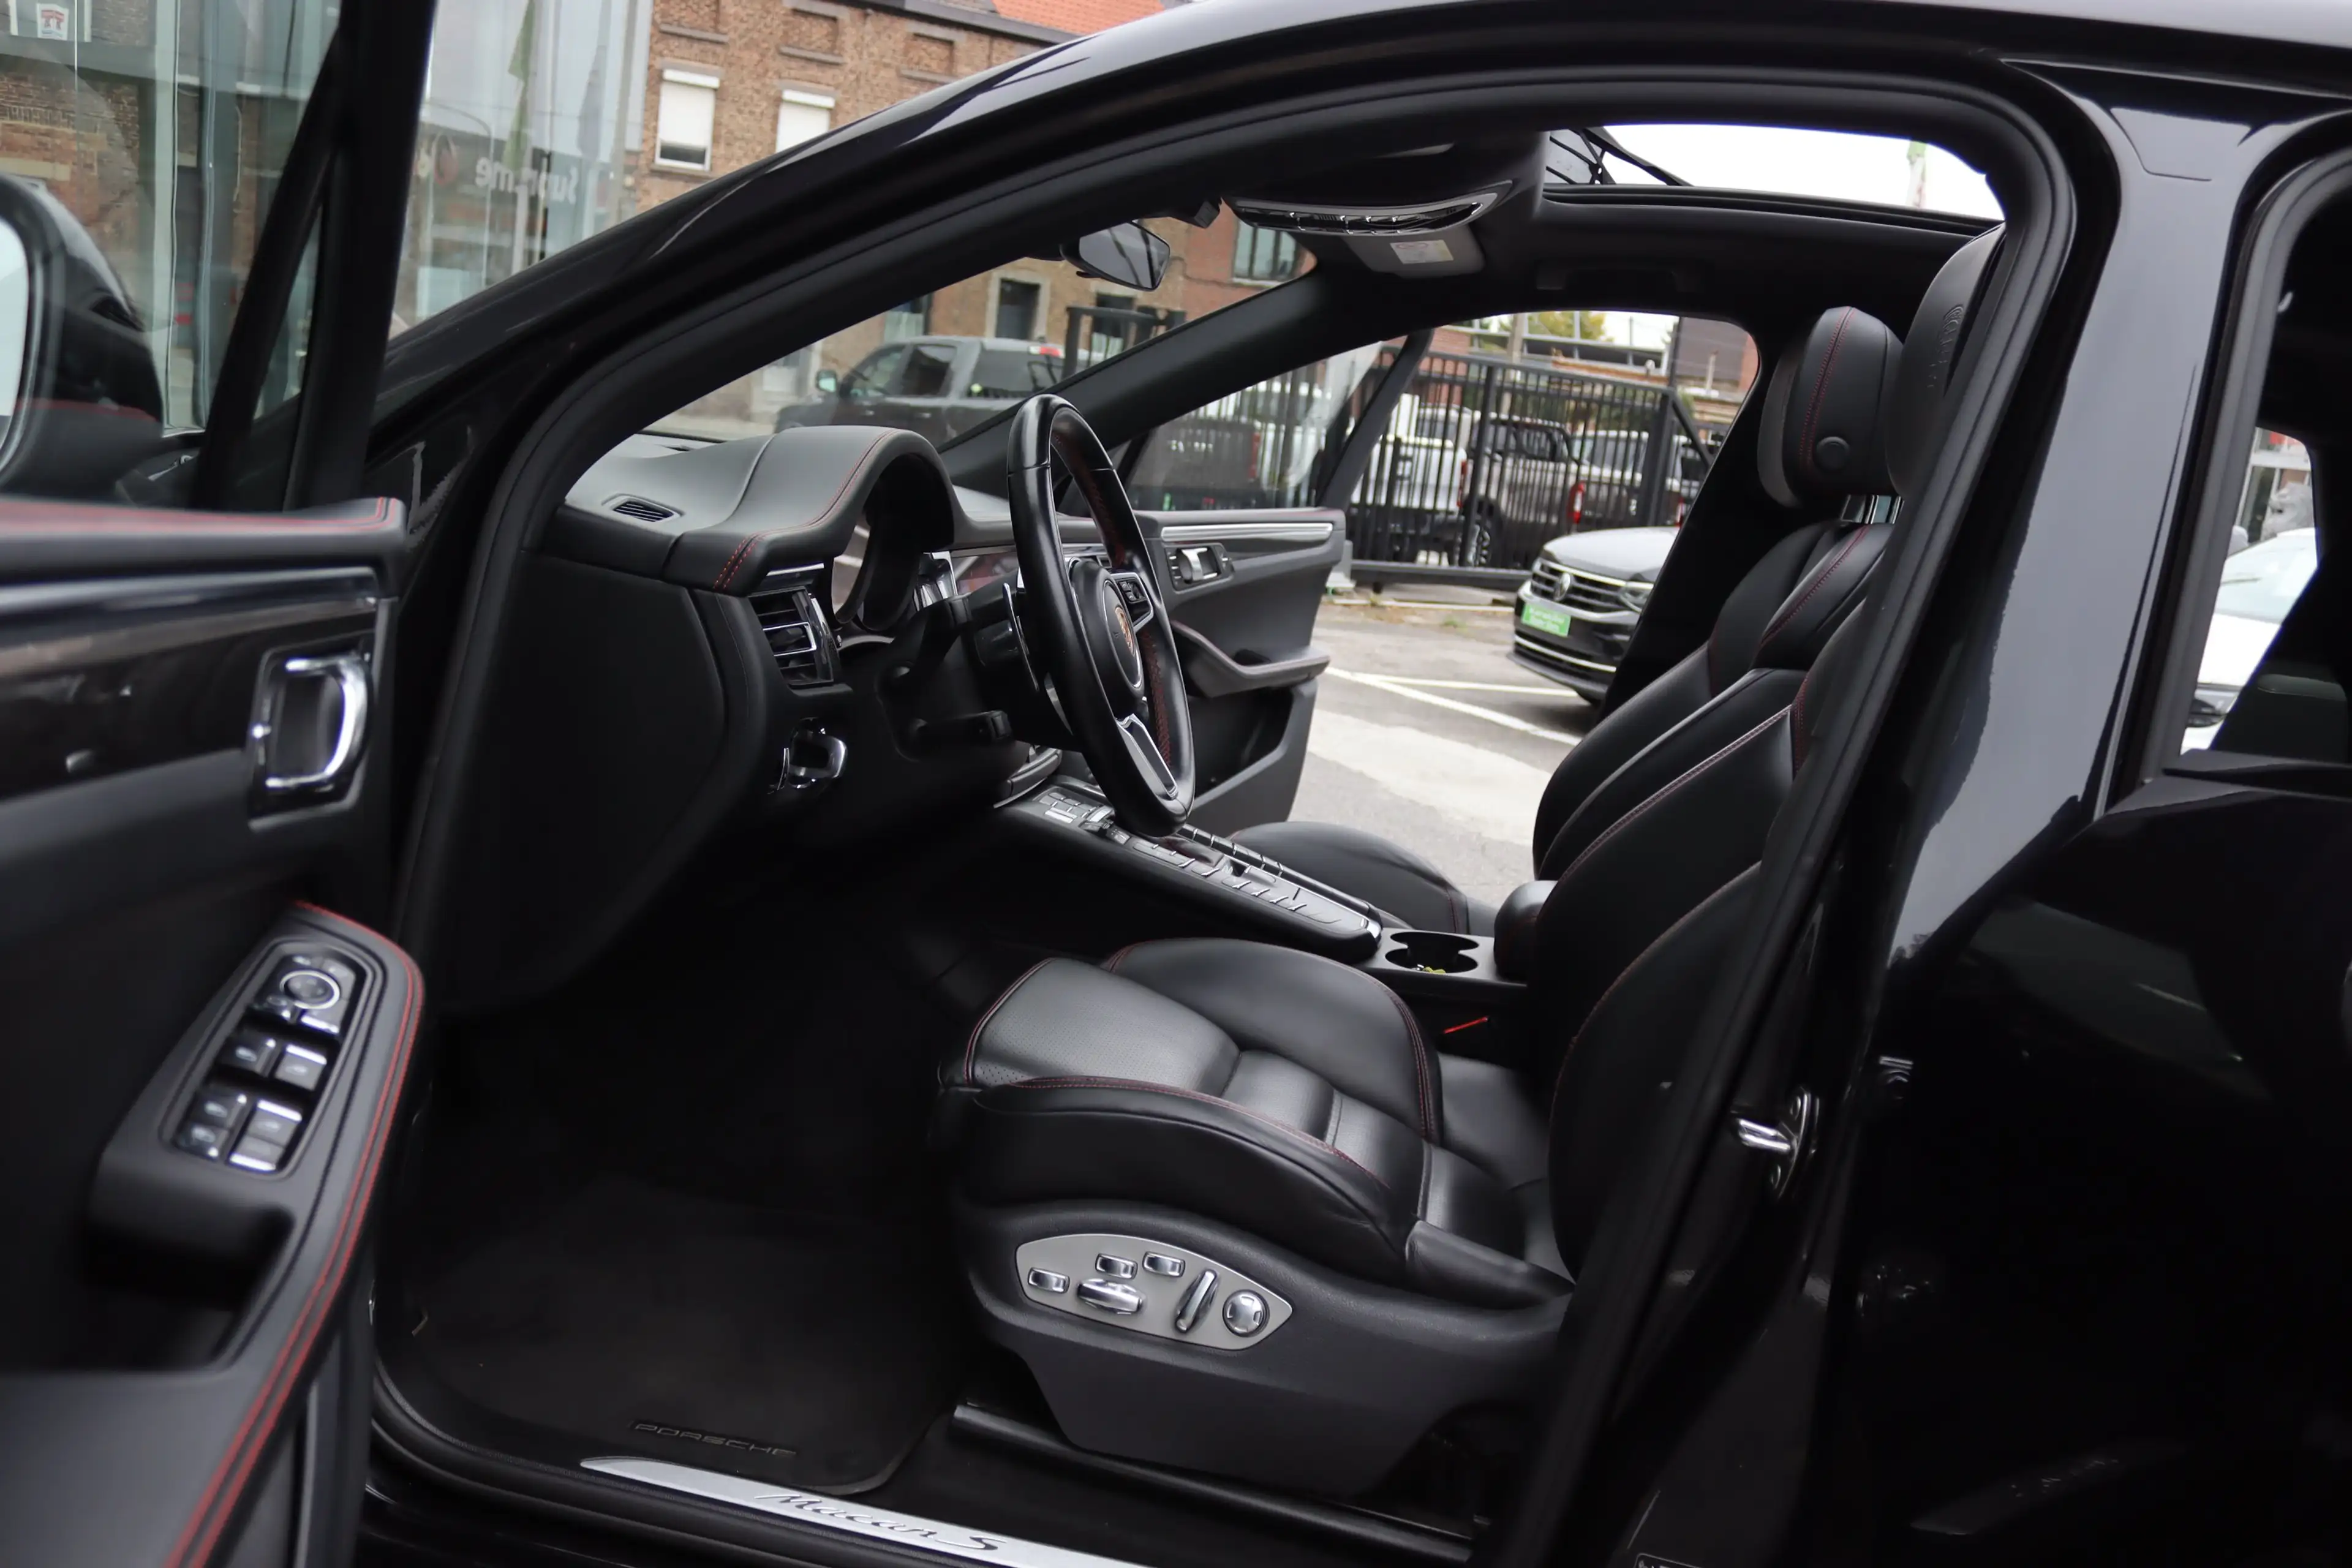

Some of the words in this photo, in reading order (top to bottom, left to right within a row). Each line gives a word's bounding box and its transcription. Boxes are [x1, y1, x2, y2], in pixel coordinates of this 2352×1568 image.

[635, 1423, 797, 1457] PORSCHE
[754, 1494, 938, 1539] Macan
[935, 1536, 1008, 1551] S
